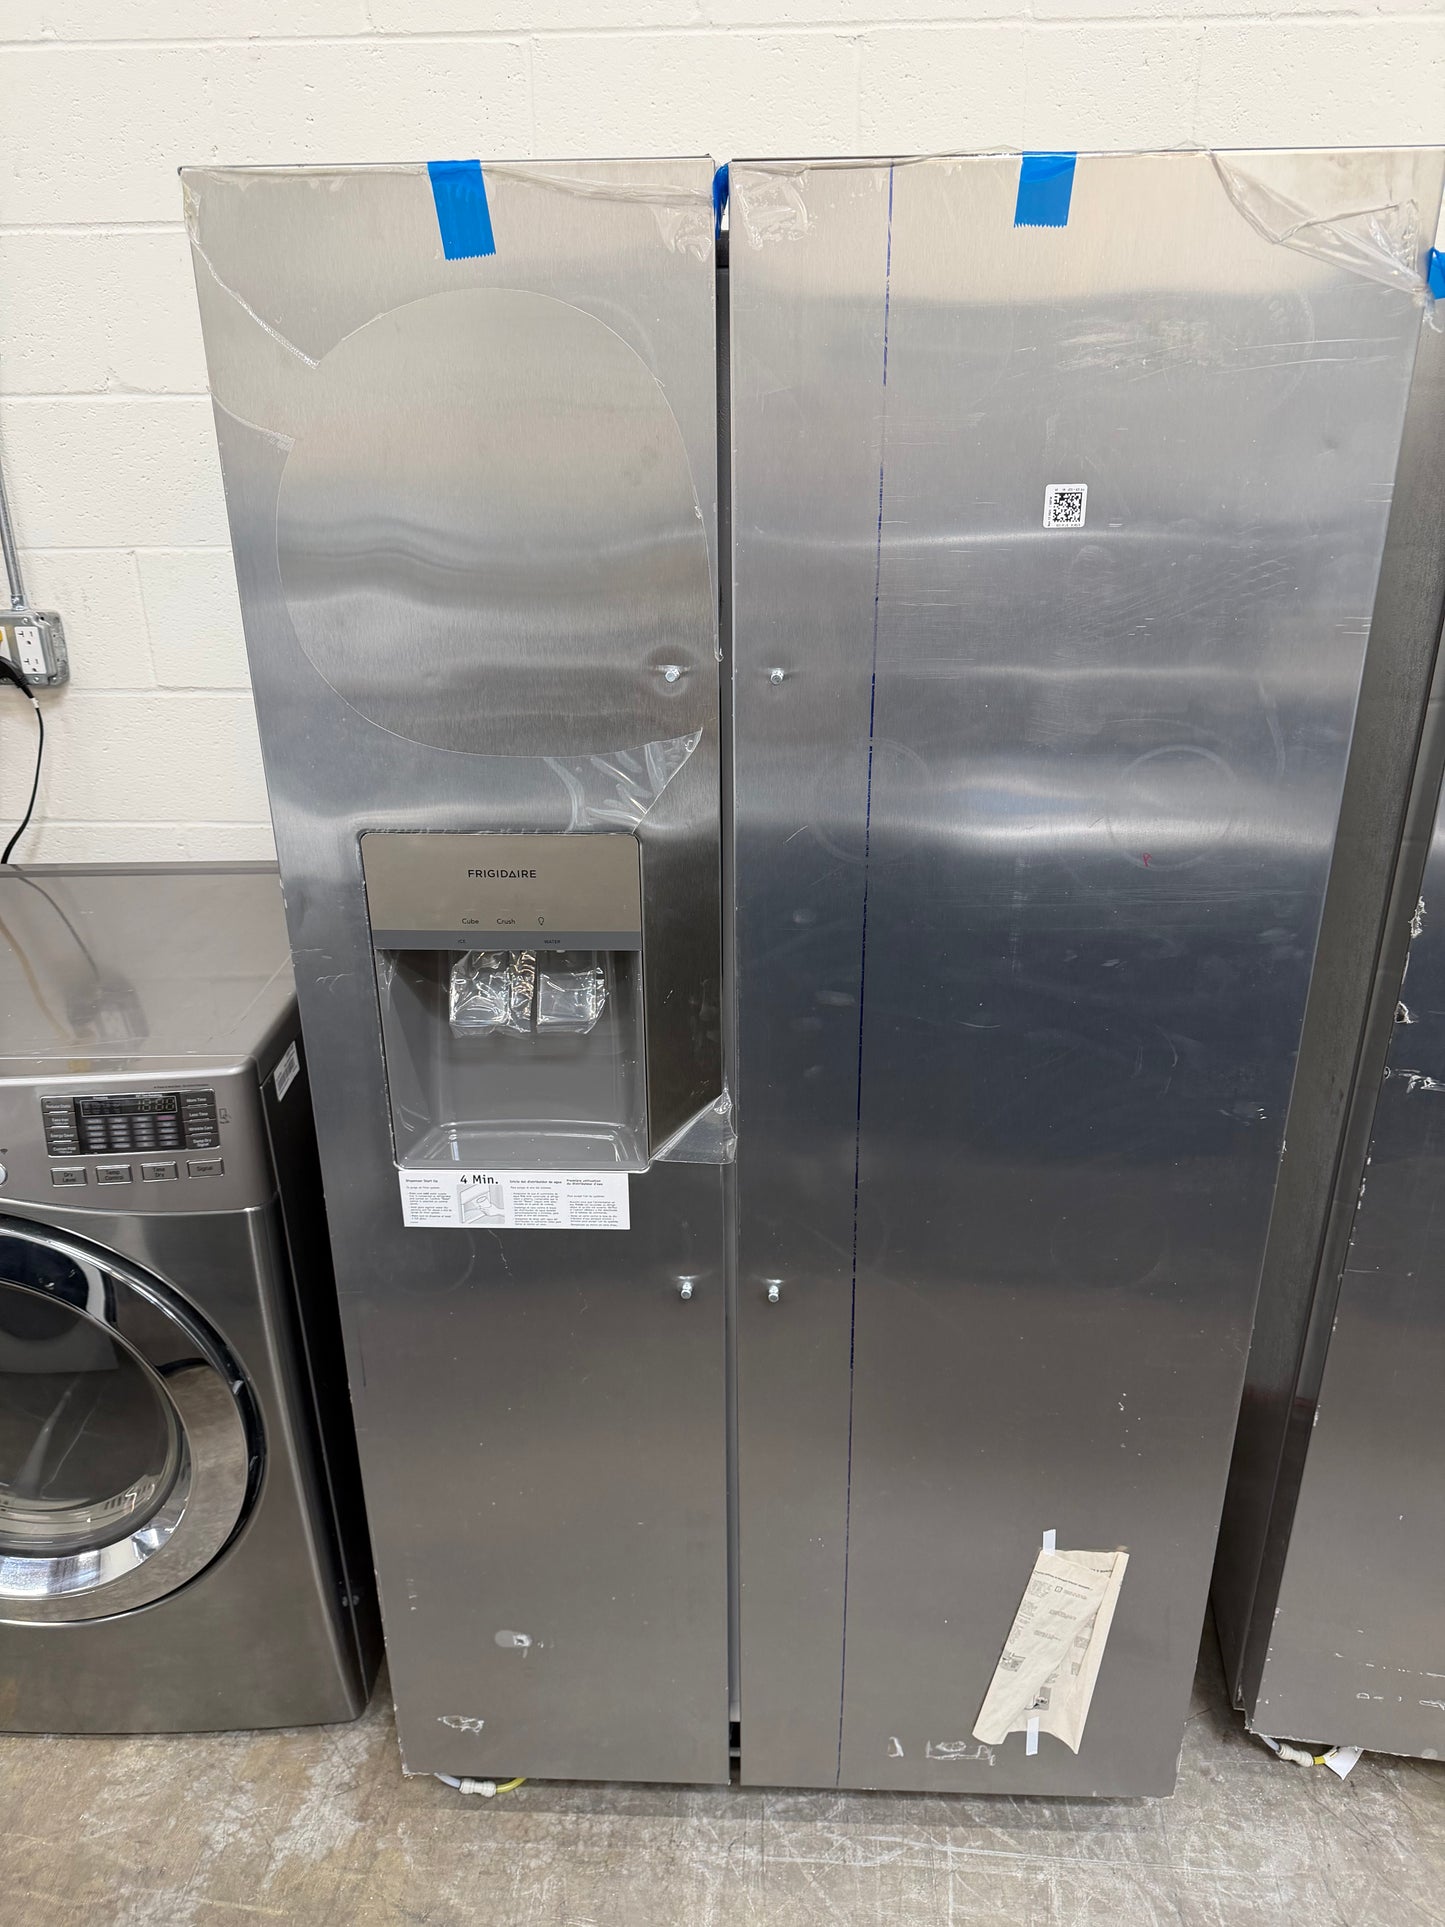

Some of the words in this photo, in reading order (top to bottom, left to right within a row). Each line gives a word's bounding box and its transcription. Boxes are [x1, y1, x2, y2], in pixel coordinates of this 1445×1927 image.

[467, 869, 537, 878] FRIGIDAIRE
[461, 917, 480, 925] Cube
[496, 917, 516, 925] Crush
[460, 1174, 468, 1184] 4
[472, 1174, 499, 1184] Min.
